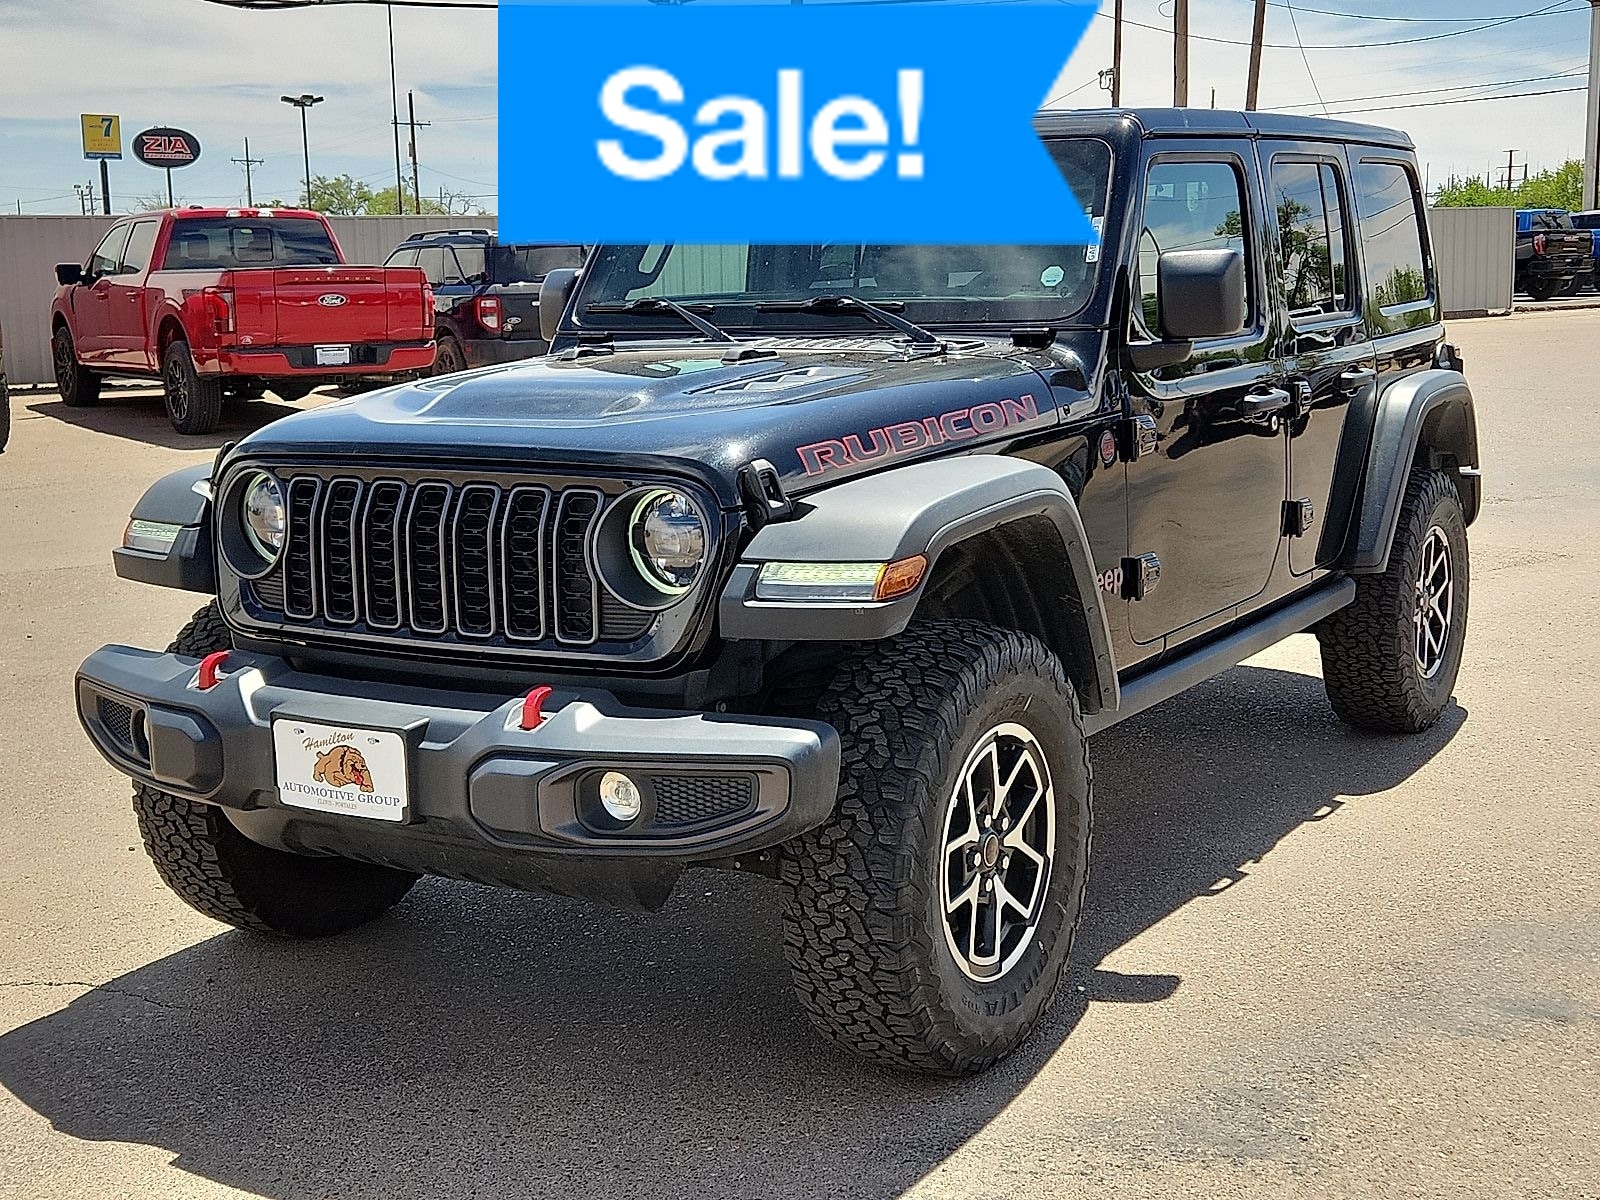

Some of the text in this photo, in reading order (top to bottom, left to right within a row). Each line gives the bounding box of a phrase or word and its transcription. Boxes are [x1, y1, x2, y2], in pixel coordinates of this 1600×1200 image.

[101, 117, 113, 138] 7
[142, 135, 192, 154] ZIA
[796, 394, 1039, 477] RUBICON
[1097, 566, 1124, 595] eep
[302, 731, 355, 751] Hamilton
[282, 781, 401, 807] AUTOMOTIVE GROUP
